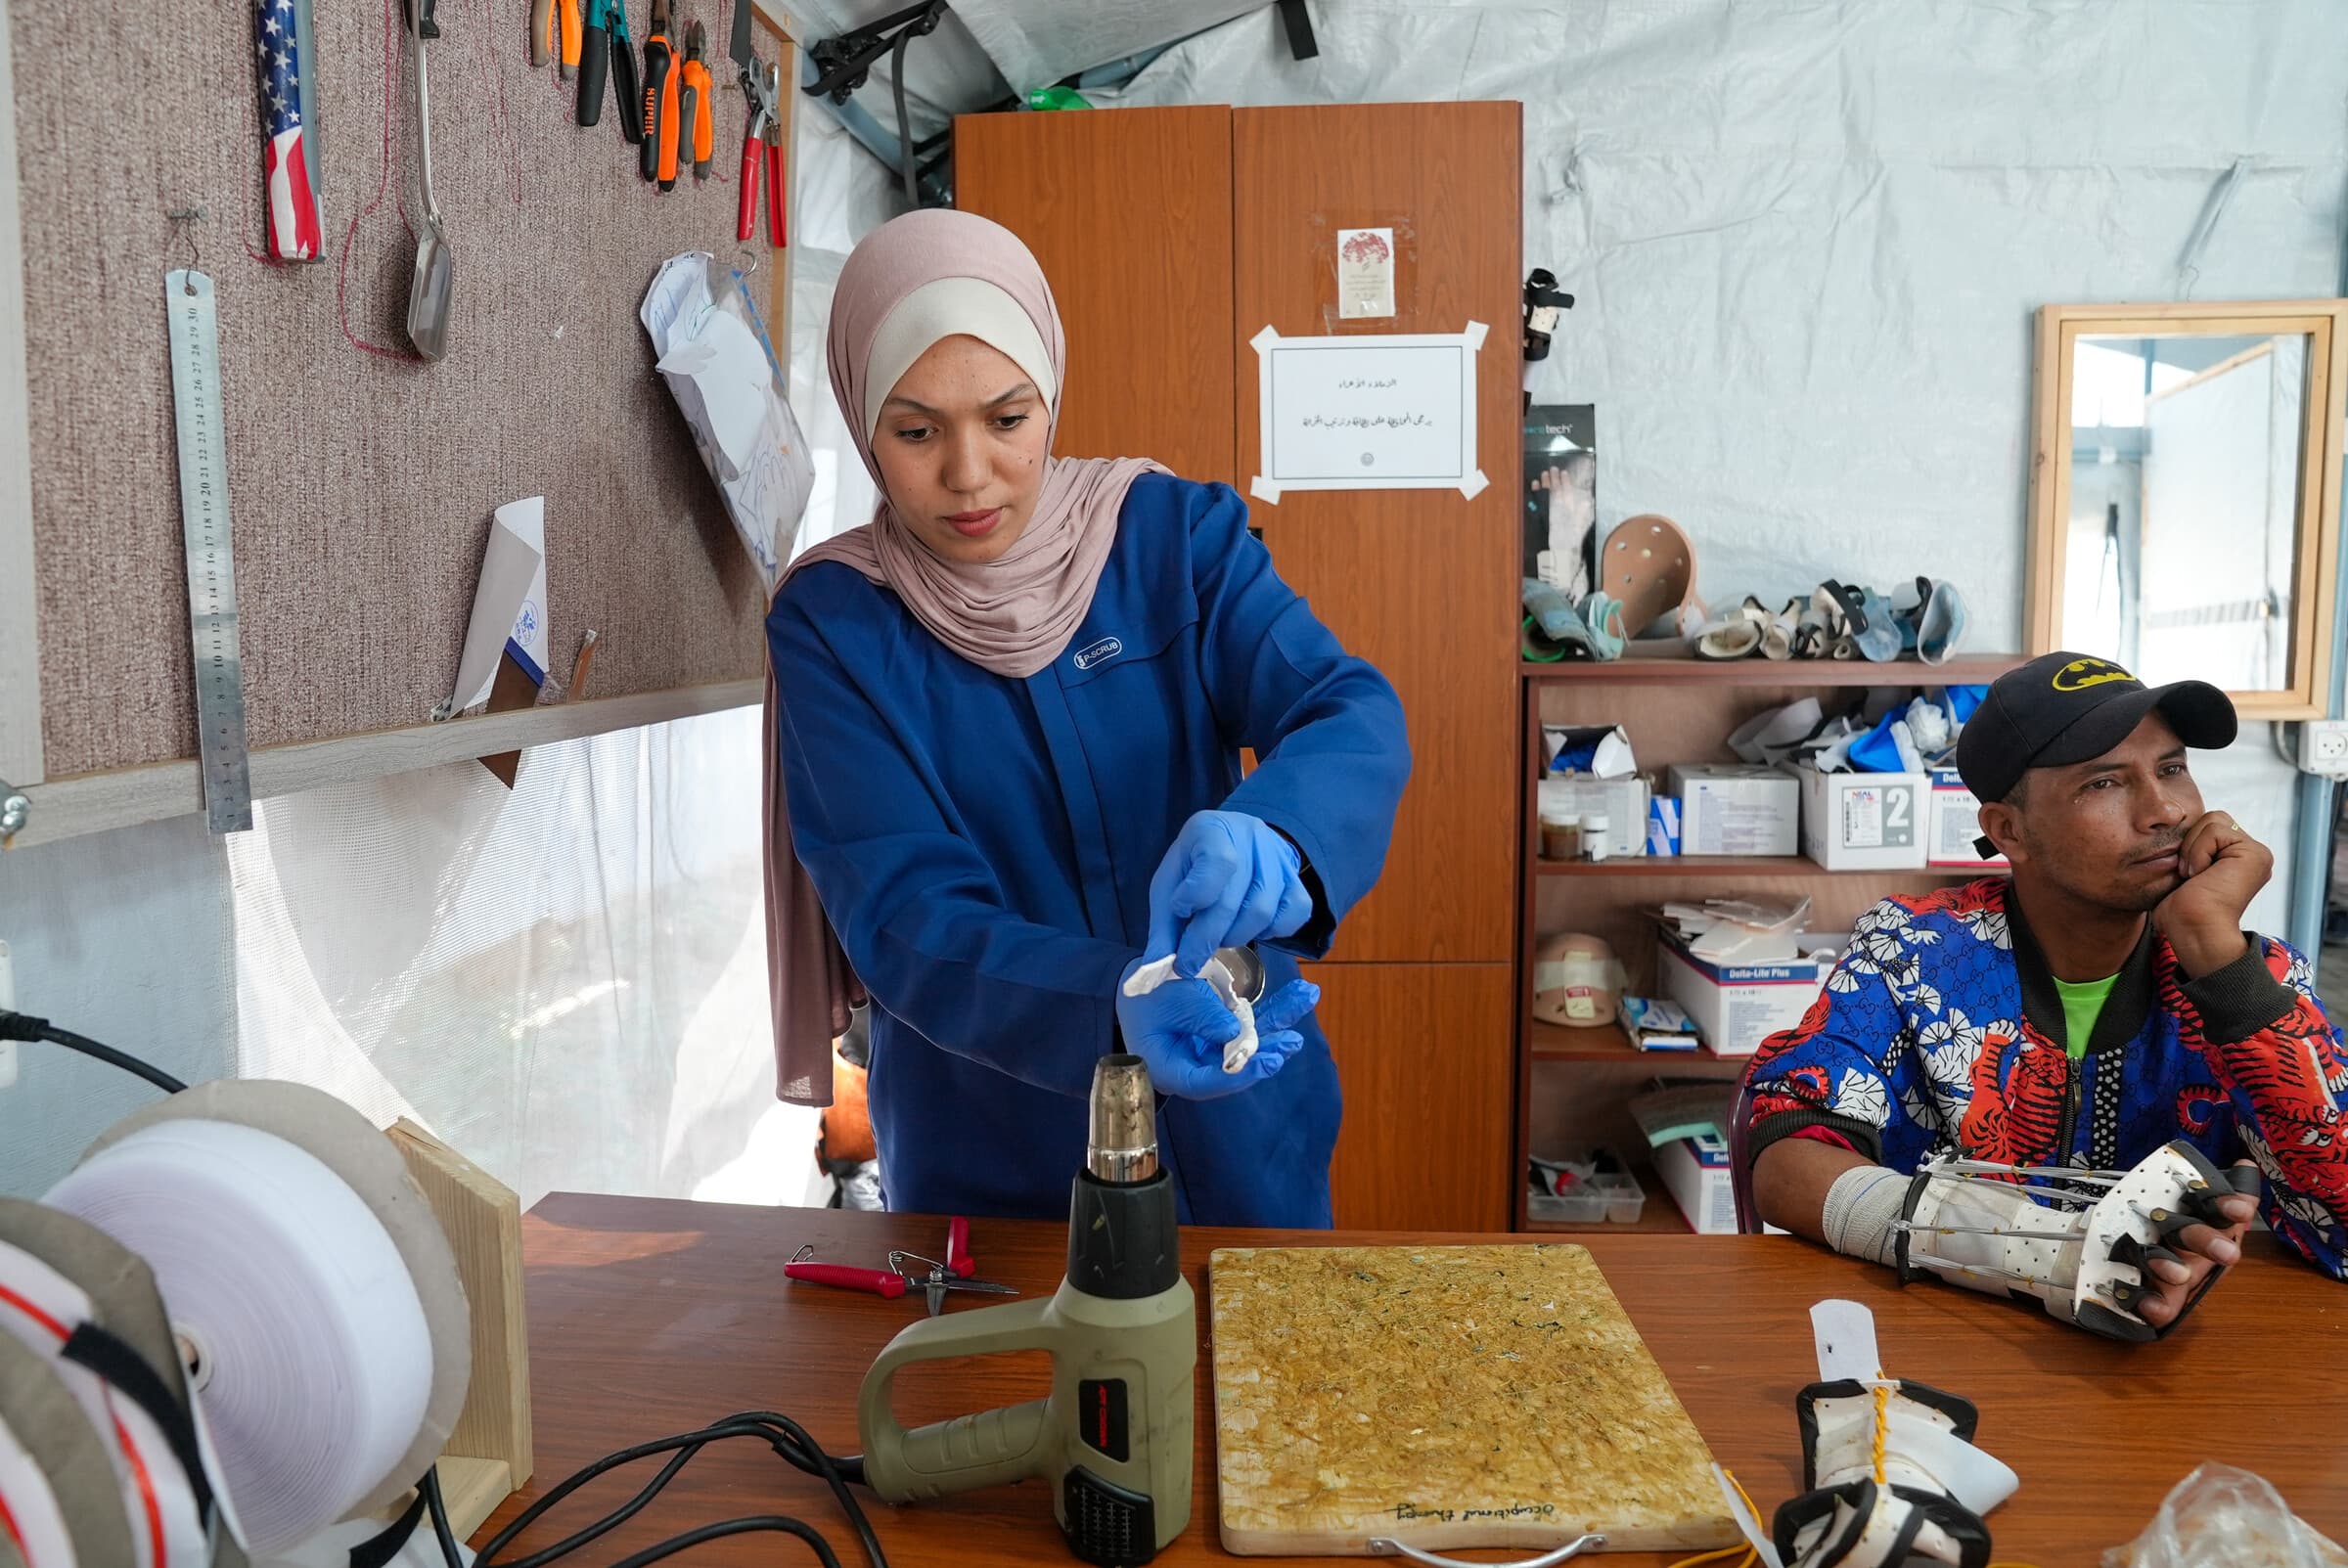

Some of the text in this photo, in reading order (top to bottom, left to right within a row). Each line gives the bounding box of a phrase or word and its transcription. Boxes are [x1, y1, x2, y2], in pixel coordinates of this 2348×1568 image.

[645, 87, 655, 135] SUPER
[192, 344, 201, 356] 28
[193, 362, 202, 374] 27
[194, 379, 203, 390] 26
[196, 396, 204, 408] 25
[197, 414, 205, 426] 24
[198, 431, 207, 443] 23
[199, 449, 207, 461] 22
[201, 467, 209, 477] 21
[201, 482, 211, 496] 20
[203, 500, 211, 512] 19
[203, 517, 212, 528] 18
[205, 535, 214, 546] 17
[206, 553, 215, 563] 16
[207, 570, 216, 580] 15
[209, 587, 217, 598] 14
[210, 605, 219, 615] 13
[211, 621, 220, 633] 12
[1084, 642, 1118, 662] P-SCRUB
[213, 655, 224, 667] 10
[1886, 786, 1910, 828] 2
[1772, 967, 1789, 978] Plus
